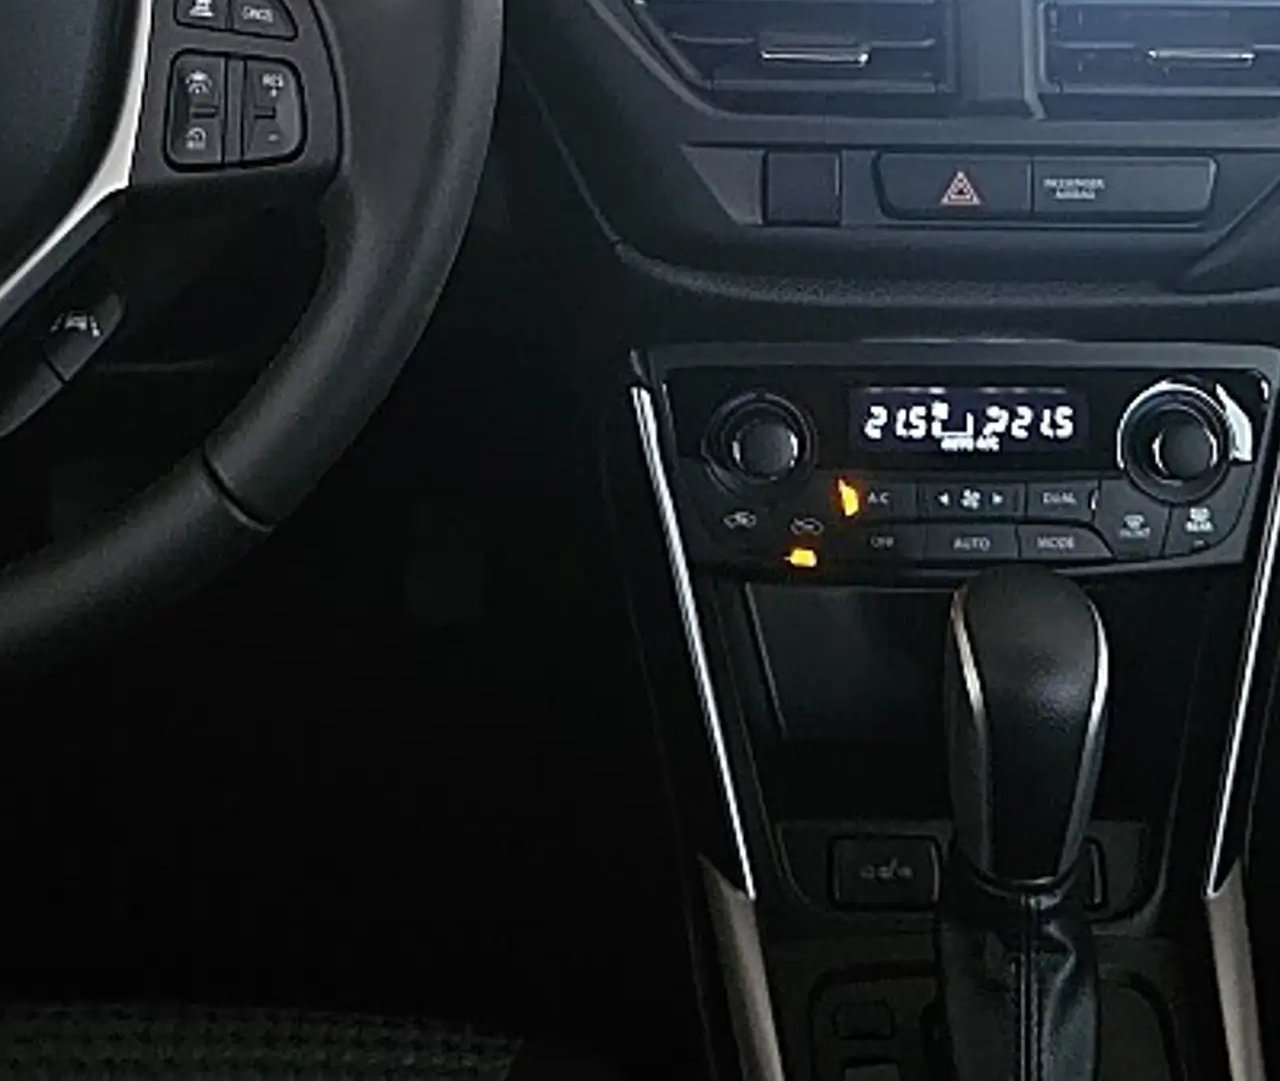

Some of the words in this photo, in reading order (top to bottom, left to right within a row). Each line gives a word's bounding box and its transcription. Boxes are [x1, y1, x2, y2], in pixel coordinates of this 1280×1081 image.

[1042, 491, 1078, 506] DUAL
[953, 536, 991, 551] AUTO
[1036, 535, 1075, 550] MODE
